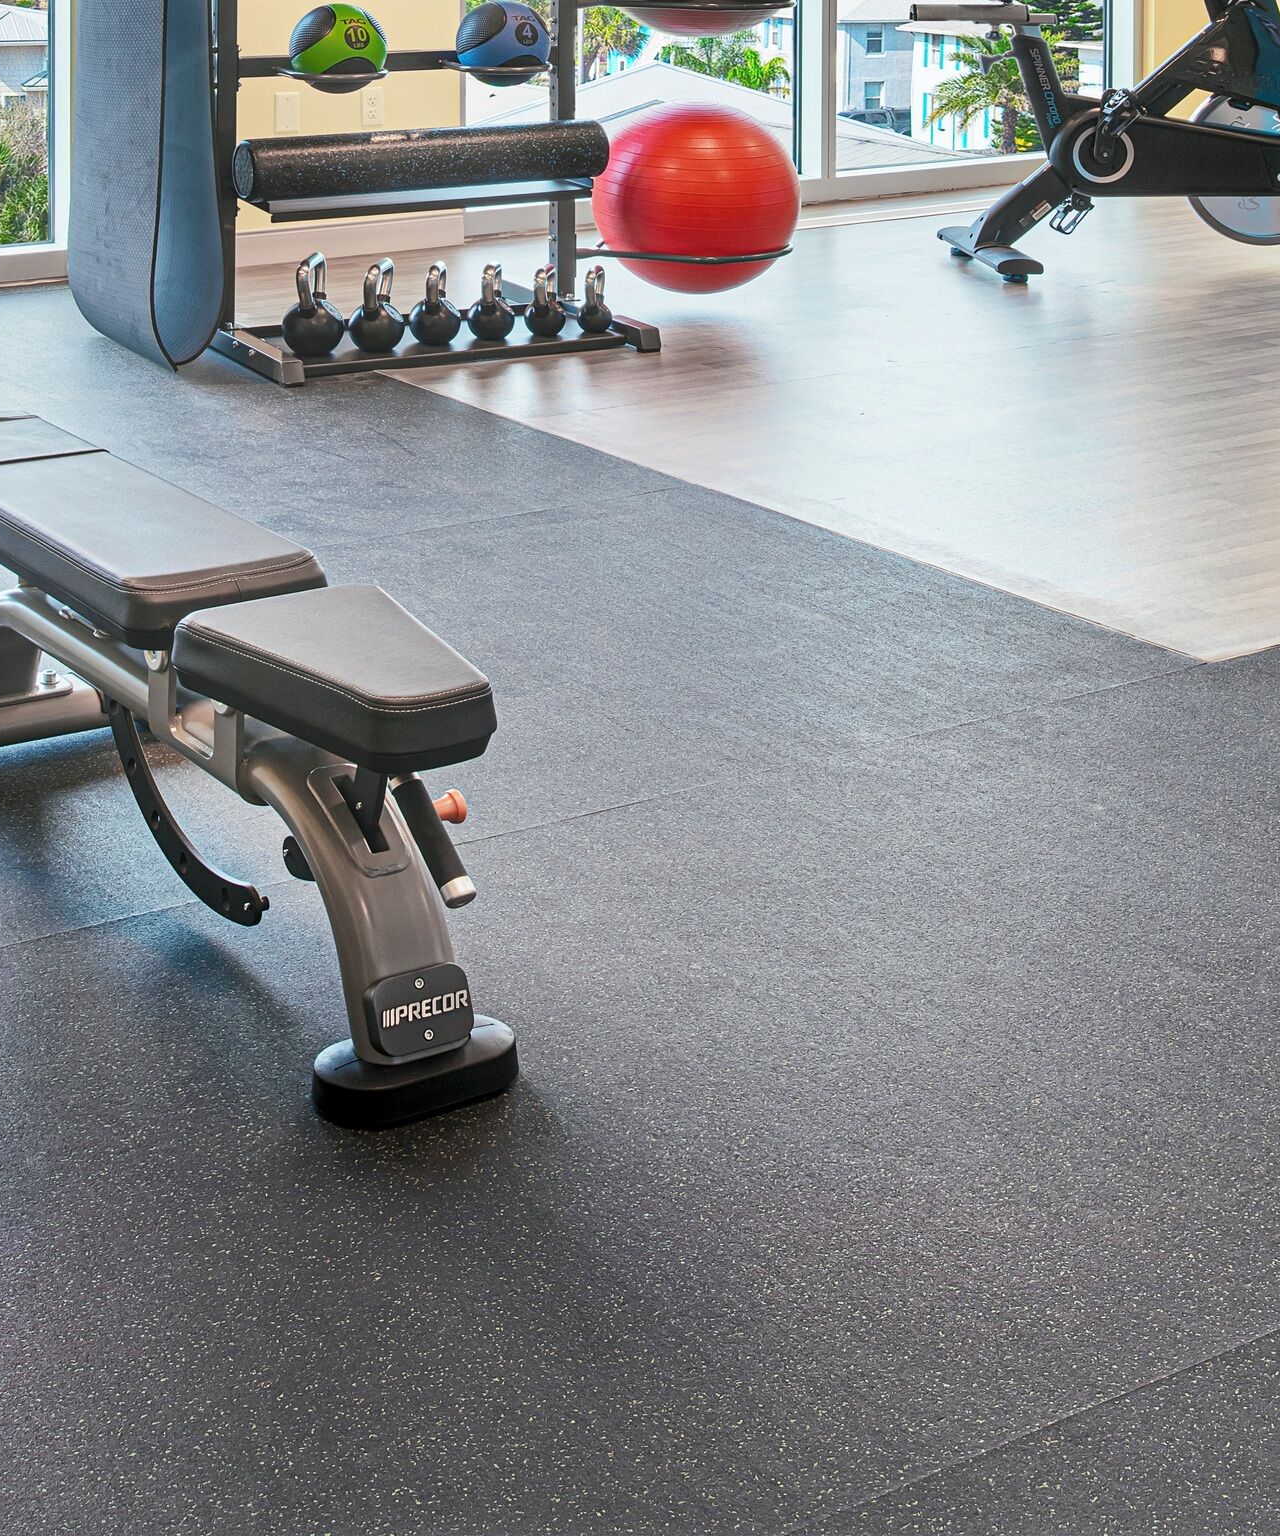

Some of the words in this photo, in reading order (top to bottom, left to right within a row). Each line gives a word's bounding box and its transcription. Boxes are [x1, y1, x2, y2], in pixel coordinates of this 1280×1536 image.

[346, 27, 367, 42] 10
[522, 24, 533, 39] 4
[1029, 48, 1051, 91] SPINNER
[1044, 91, 1061, 124] Chrono
[395, 989, 469, 1026] PRECOR
